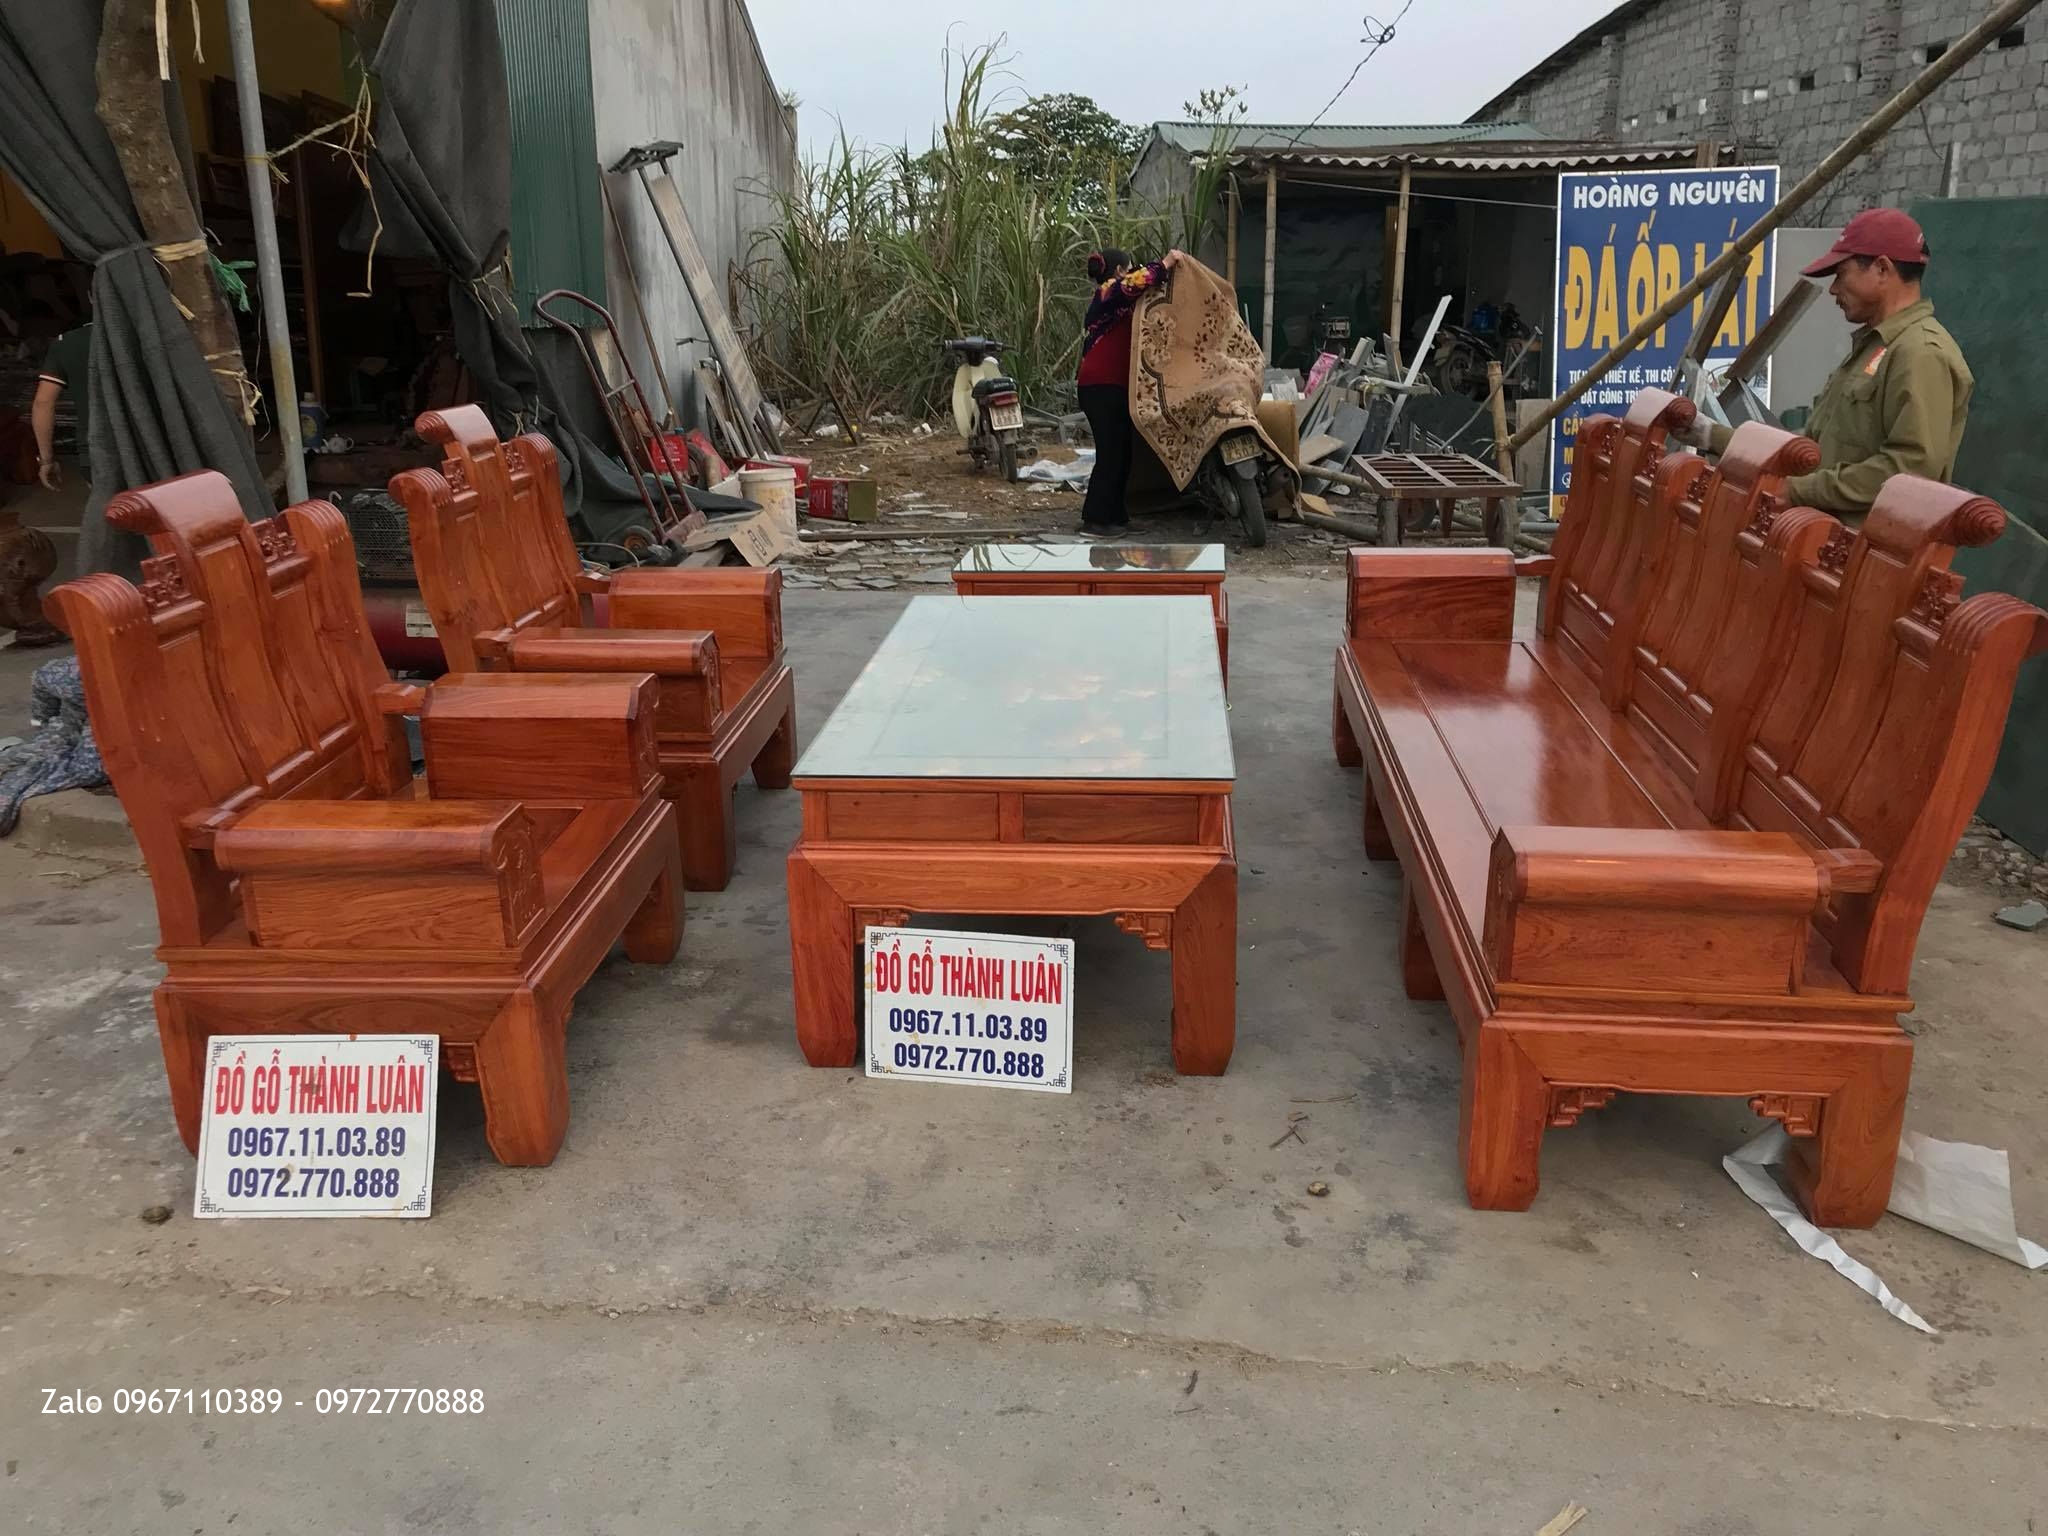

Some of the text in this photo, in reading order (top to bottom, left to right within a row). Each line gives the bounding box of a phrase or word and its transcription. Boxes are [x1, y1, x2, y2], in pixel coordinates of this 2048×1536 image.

[1573, 173, 1766, 209] HOÀNG NGUYÊN
[1645, 369, 1659, 383] THI
[1599, 387, 1623, 405] CÔNG
[875, 938, 1063, 1005] ĐỒ GỖ THÀNH LUÂN
[889, 1007, 1048, 1043] 0967.11.03.89
[894, 1042, 1044, 1078] 0972.770.888
[214, 1048, 426, 1115] ĐỒ GỖ THÀNH LUÂN
[227, 1126, 406, 1157] 0967.11.03.89
[227, 1167, 400, 1198] 0972.770.888
